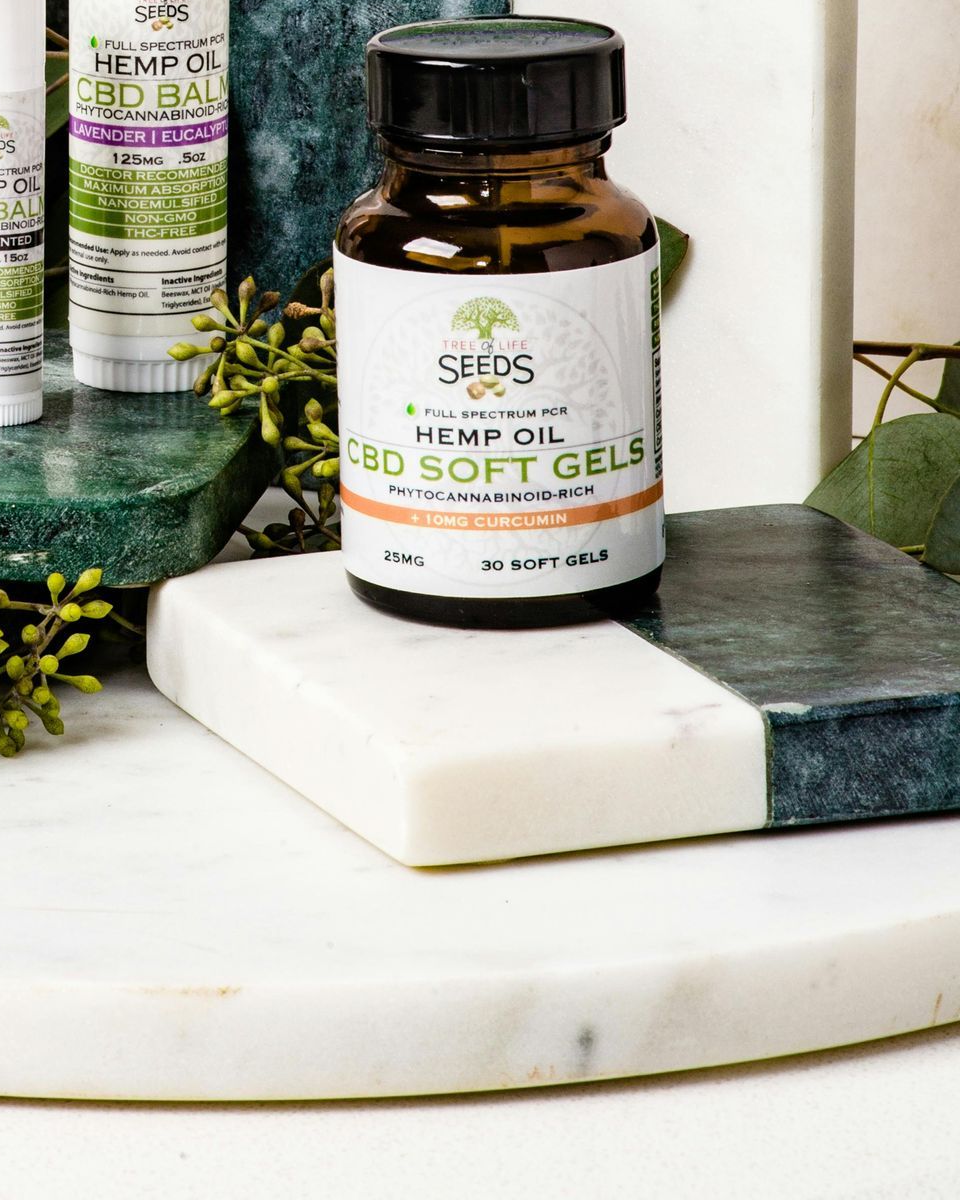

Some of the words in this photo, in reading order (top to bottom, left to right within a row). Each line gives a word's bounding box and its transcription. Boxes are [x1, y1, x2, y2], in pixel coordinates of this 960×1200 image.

[135, 4, 189, 22] SEEDS
[105, 40, 136, 51] FULL
[140, 39, 207, 51] SPECTRUM
[210, 33, 224, 46] PCR
[95, 53, 178, 75] HEMP
[187, 50, 221, 73] OIL
[77, 77, 144, 108] CBD
[74, 122, 145, 142] LAVENDER
[80, 165, 131, 179] DOCTOR
[136, 160, 227, 180] RECOMMENDED
[14, 176, 40, 194] OIL
[84, 180, 146, 194] MAXIMUM
[151, 175, 225, 195] ABSORPTION
[98, 194, 217, 209] NANOEMULSIFIED
[125, 212, 196, 223] NON-GMO
[125, 226, 197, 238] THC-FREE
[110, 248, 129, 257] Apply
[172, 247, 191, 255] Avoid
[162, 276, 192, 284] Inactive
[117, 291, 137, 299] Hemp
[444, 340, 476, 350] TREE
[499, 340, 528, 350] LIFE
[439, 354, 534, 385] SEEDS
[425, 408, 456, 419] FULL
[461, 409, 536, 419] SPECTRUM
[542, 407, 567, 416] PCR
[416, 426, 500, 446] HEMP
[514, 427, 564, 444] OIL
[348, 438, 404, 476] CBD
[420, 456, 537, 484] SOFT
[553, 438, 644, 479] GELS
[389, 485, 594, 502] PHYTOCANNABINOID-RICH
[425, 515, 468, 527] 10MG
[474, 513, 566, 528] CURCUMIN
[384, 550, 424, 566] 25MG
[482, 560, 504, 571] 30
[512, 557, 560, 570] SOFT
[566, 550, 608, 566] GELS
